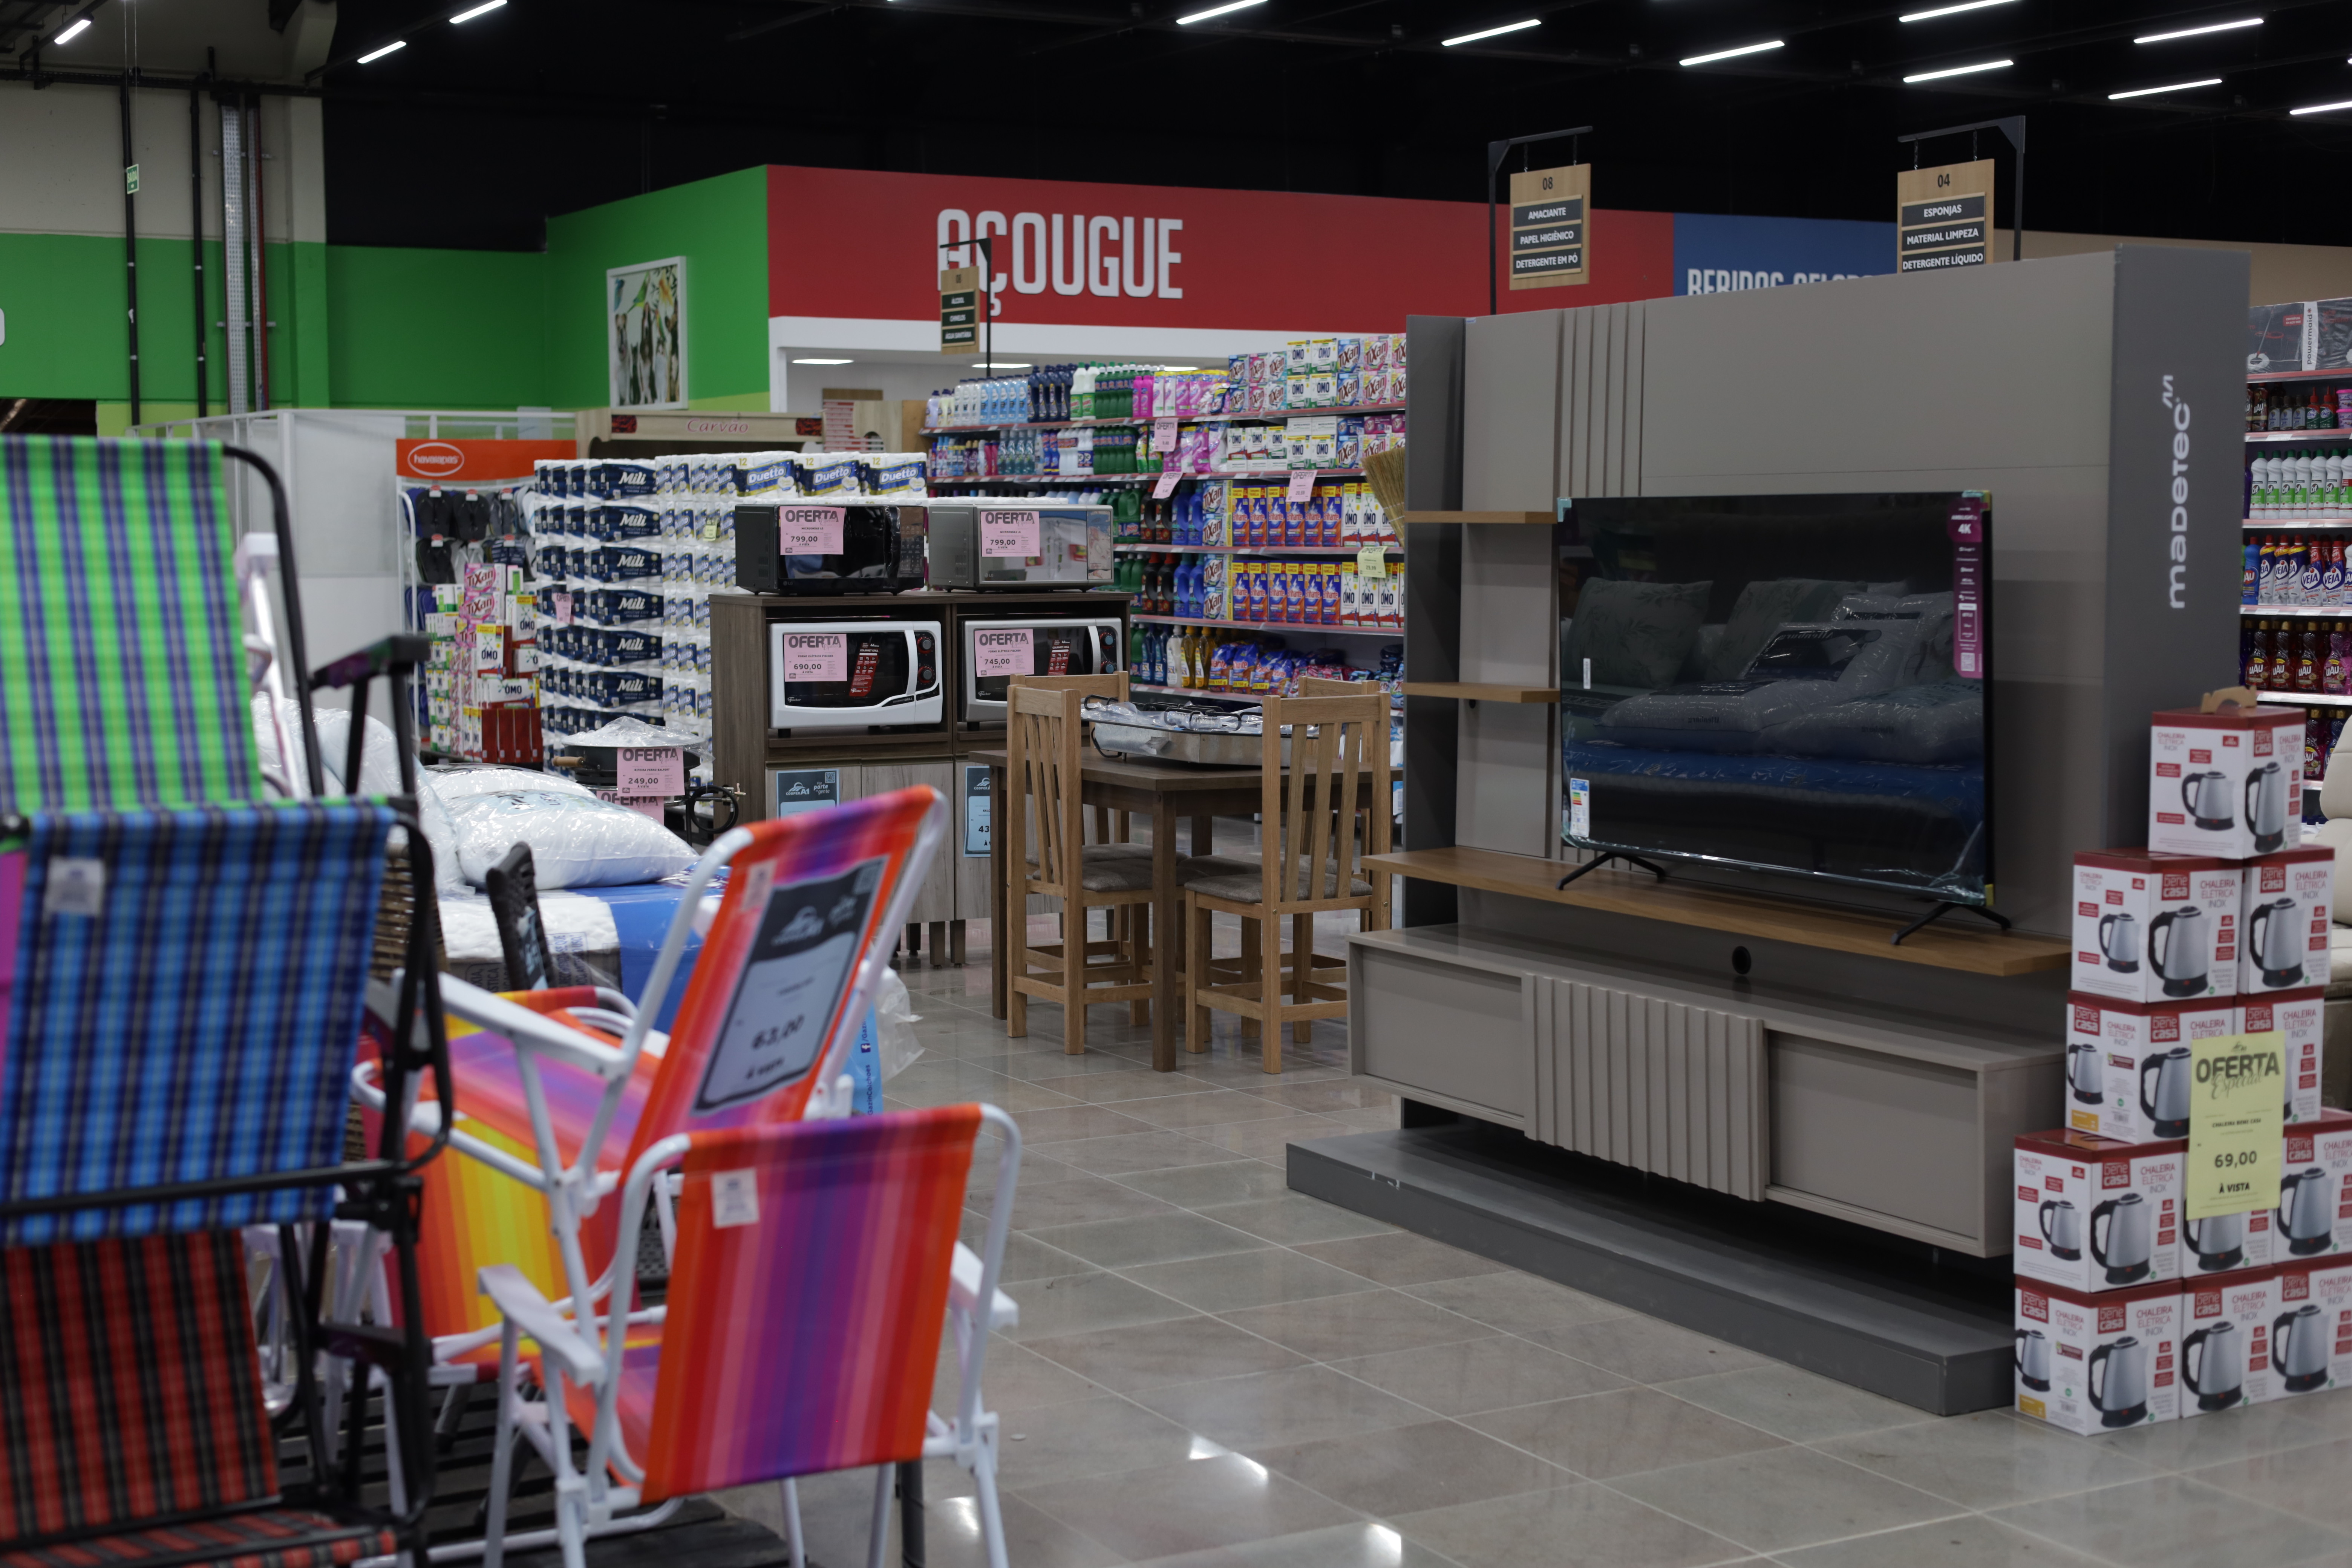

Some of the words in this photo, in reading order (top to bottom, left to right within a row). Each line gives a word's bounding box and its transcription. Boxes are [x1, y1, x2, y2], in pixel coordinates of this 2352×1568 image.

[1543, 177, 1553, 190] 08
[1938, 173, 1950, 187] 04
[1528, 207, 1566, 220] AMACIANTE
[1924, 204, 1962, 217] ESPONJAS
[1520, 234, 1539, 245] PAPEL
[1907, 233, 1944, 245] MATERIAL
[1946, 228, 1978, 240] LIMPEZA
[937, 209, 1183, 316] AÇOUGUE
[1516, 257, 1557, 268] DETERGENTE
[1568, 252, 1578, 263] PÓ
[1903, 257, 1949, 270] DETERGENTE
[1951, 253, 1983, 265] LÍQUIDO
[2254, 403, 2263, 413] UAU
[687, 418, 749, 433] Carvão
[872, 457, 880, 466] 12
[619, 472, 646, 485] Mili
[747, 466, 786, 485] Duetto
[815, 466, 851, 485] Duetto
[880, 466, 918, 485] Duetto
[619, 514, 647, 527] Mili
[785, 510, 839, 522] OFERTA
[985, 512, 1035, 524] OFERTA
[1345, 514, 1357, 524] OMO
[1363, 513, 1375, 524] OMO
[1958, 524, 1972, 534] 4K
[617, 554, 645, 567] Mili
[2303, 574, 2318, 584] VEJA
[2324, 573, 2340, 584] VEJA
[618, 597, 645, 610] Mili
[617, 638, 644, 651] Mili
[789, 636, 841, 648] OFERTA
[979, 633, 1029, 646] OFERTA
[481, 650, 498, 660] OMO
[2249, 665, 2263, 674] UAU
[2273, 665, 2285, 675] UAU
[2299, 666, 2311, 676] UAU
[2326, 666, 2339, 676] UAU
[505, 685, 522, 694] OMO
[617, 679, 643, 692] Mili
[2255, 742, 2272, 752] casa
[623, 748, 678, 761] OFERTA
[2262, 867, 2285, 879] bene
[2295, 871, 2328, 882] CHALEIRA
[2164, 873, 2188, 887] bene
[2200, 879, 2236, 890] CHALEIRA
[2262, 879, 2285, 891] casa
[2296, 880, 2327, 891] ELÉTRICA
[2163, 887, 2188, 899] casa
[2201, 889, 2234, 900] ELÉTRICA
[2303, 890, 2320, 899] INOX
[2208, 899, 2226, 908] INOX
[2248, 1007, 2271, 1018] bene
[2283, 1009, 2317, 1020] CHALEIRA
[2153, 1017, 2177, 1029] bene
[2190, 1019, 2225, 1030] CHALEIRA
[2247, 1019, 2271, 1031] casa
[2285, 1019, 2315, 1029] ELÉTRICA
[2153, 1029, 2178, 1039] casa
[2292, 1029, 2308, 1038] INOX
[2196, 1052, 2280, 1083] OFERTA
[2211, 1069, 2262, 1099] Especial
[2289, 1138, 2312, 1150] bene
[2215, 1151, 2257, 1168] 69,00
[2289, 1149, 2312, 1160] casa
[2104, 1164, 2128, 1175] bene
[2141, 1163, 2176, 1175] CHALEIRA
[2104, 1174, 2128, 1186] casa
[2142, 1173, 2173, 1185] ELÉTRICA
[2150, 1184, 2167, 1194] INOX
[2219, 1183, 2225, 1193] À
[2227, 1182, 2250, 1192] VISTA
[2232, 1291, 2267, 1303] CHALEIRA
[2100, 1308, 2124, 1320] bene
[2136, 1305, 2173, 1318] CHALEIRA
[2233, 1302, 2265, 1314] ELÉTRICA
[2099, 1318, 2124, 1331] casa
[2138, 1316, 2171, 1328] ELÉTRICA
[2145, 1327, 2164, 1336] INOX
